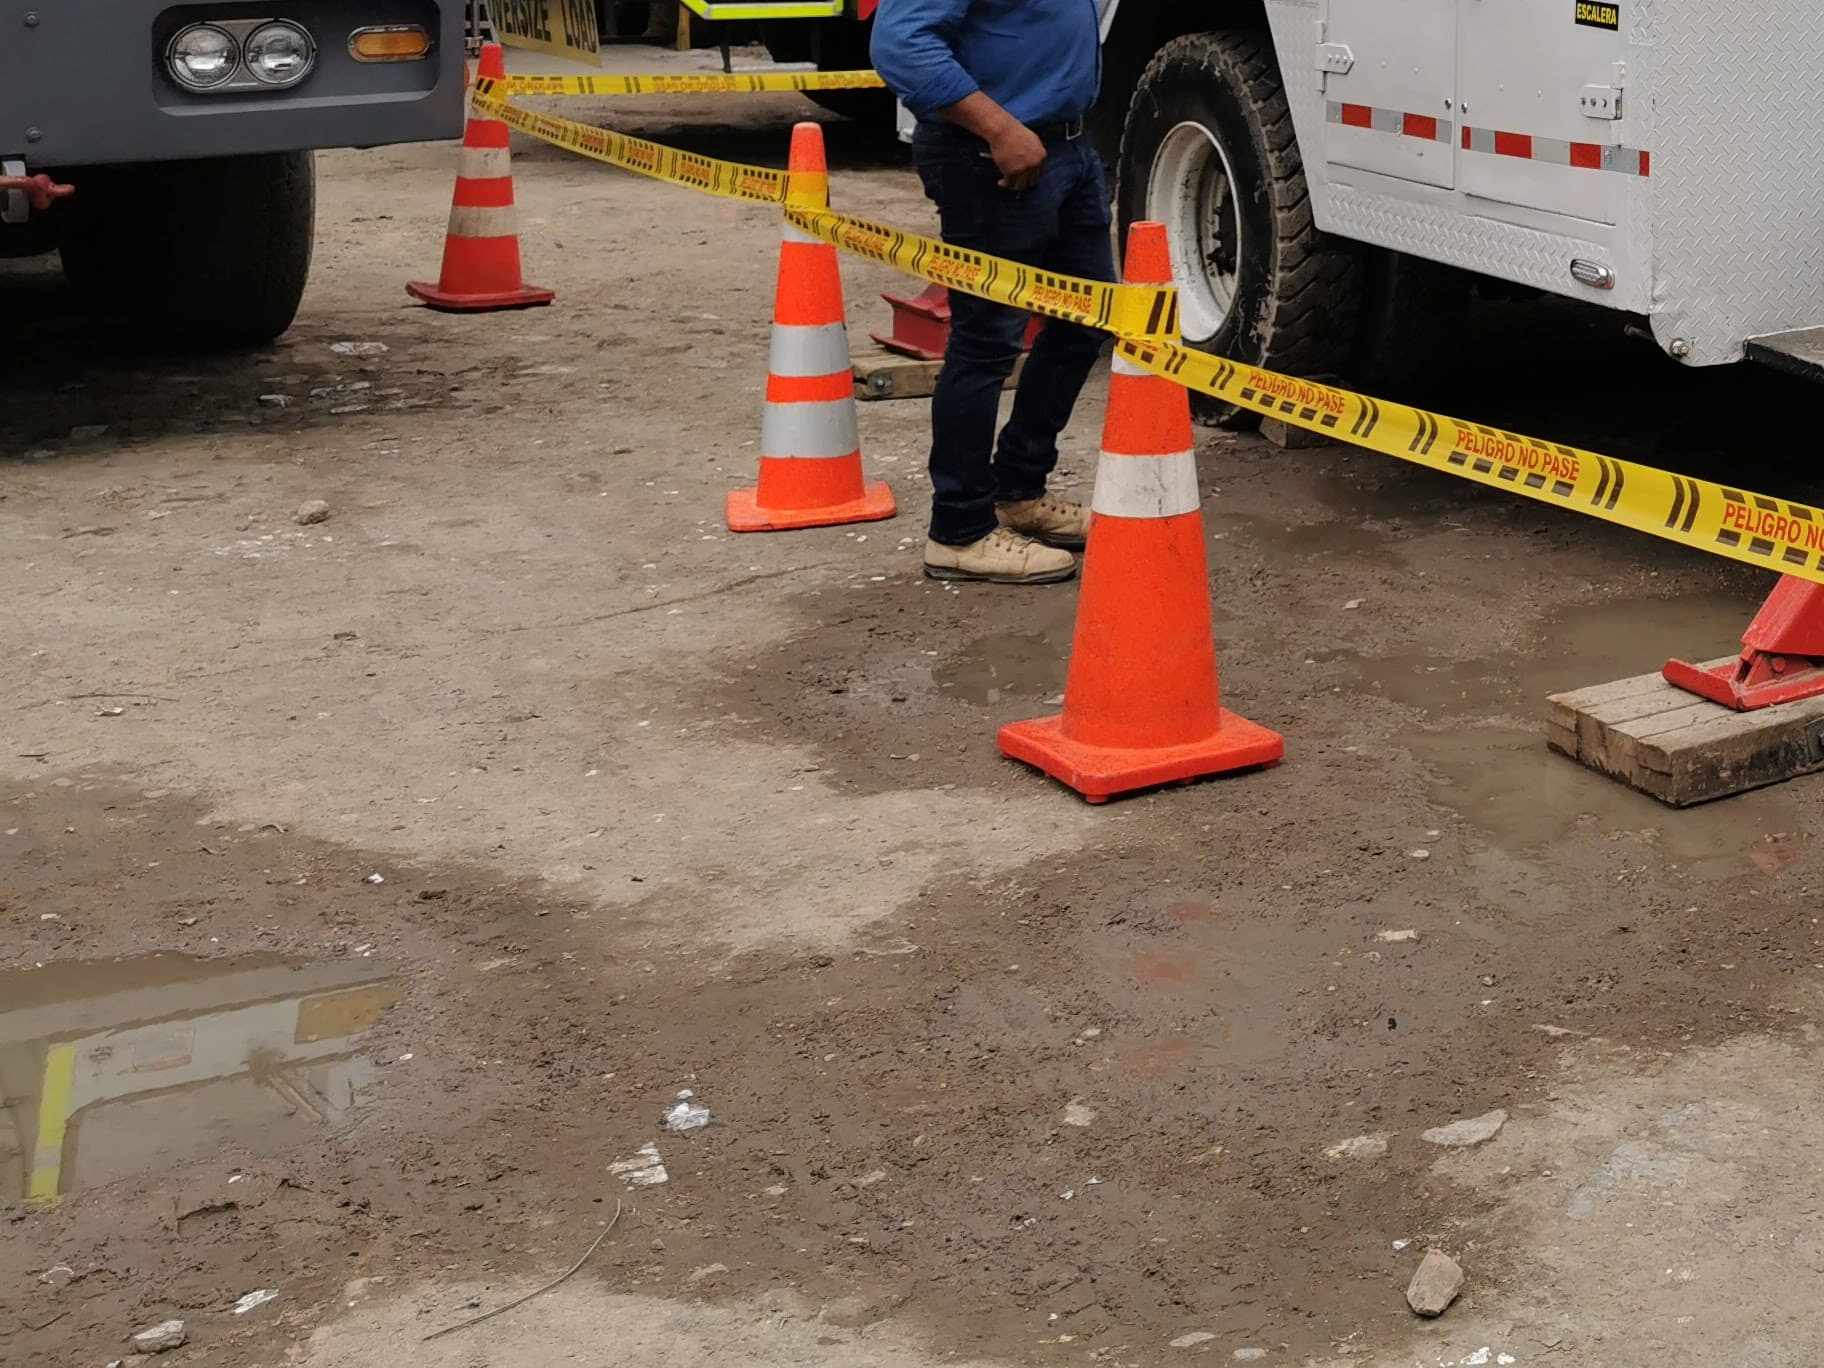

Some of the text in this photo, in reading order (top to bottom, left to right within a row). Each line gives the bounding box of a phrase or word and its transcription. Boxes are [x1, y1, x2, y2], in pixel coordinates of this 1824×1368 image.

[1576, 2, 1617, 25] ESCALERA
[1031, 284, 1062, 310] PELIGRO
[1074, 296, 1093, 315] PASE
[1248, 373, 1345, 414] PELIGRO NO PASE
[1456, 429, 1580, 481] PELIGRO NO PASE
[1723, 502, 1801, 544] PELIGRO
